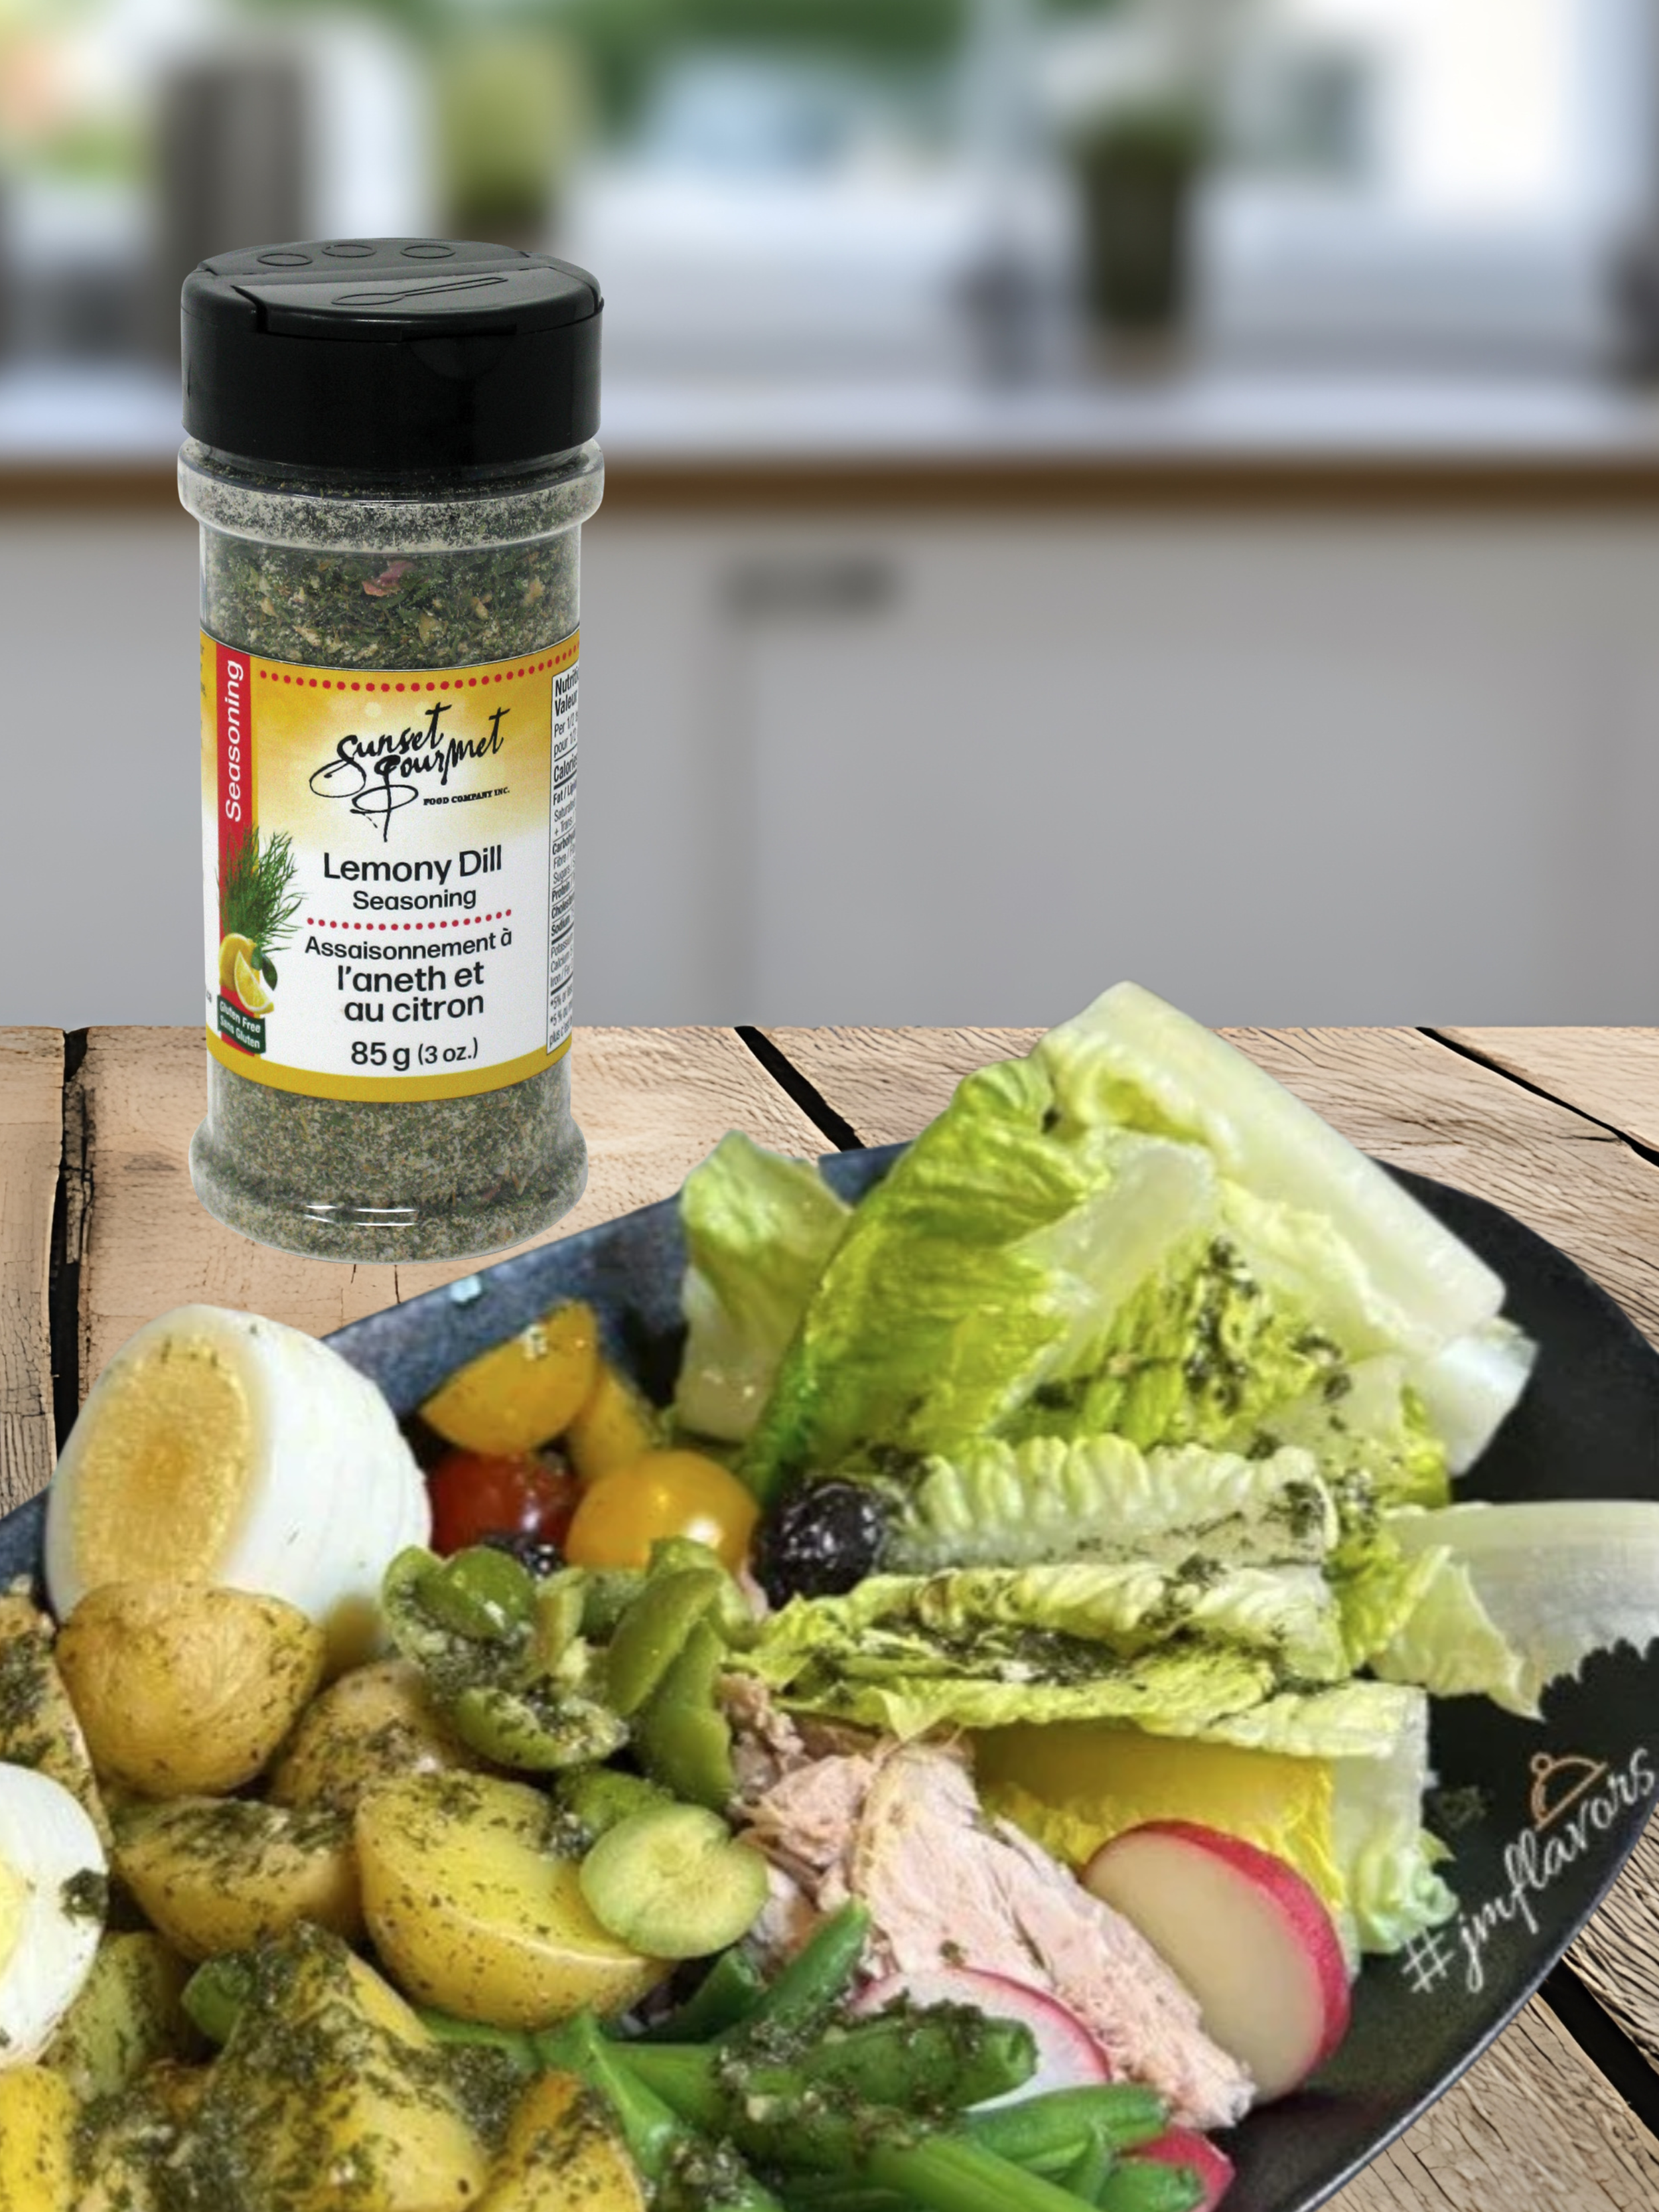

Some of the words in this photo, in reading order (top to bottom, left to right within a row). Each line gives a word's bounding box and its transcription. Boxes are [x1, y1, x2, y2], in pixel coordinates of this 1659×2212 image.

[555, 689, 577, 717] Valeur
[225, 660, 244, 822] Seasoning
[554, 722, 565, 738] Per
[309, 701, 452, 798] Sunset
[554, 737, 568, 759] pour
[451, 790, 492, 803] COMPANY
[494, 786, 510, 798] INC.
[553, 790, 563, 806] Fat
[324, 852, 452, 885] Lemony
[459, 844, 502, 877] Dill
[353, 889, 476, 911] Seasoning
[305, 932, 496, 960] Assaisonnement
[500, 928, 512, 946] à
[338, 965, 447, 992] l'aneth
[454, 962, 484, 988] et
[219, 1000, 240, 1025] Gluten
[242, 1017, 261, 1033] Free
[344, 1001, 384, 1022] au
[392, 995, 484, 1022] citron
[220, 1015, 234, 1035] Sans
[236, 1027, 260, 1049] Gluten
[350, 1041, 387, 1066] 85
[392, 1047, 410, 1071] g
[417, 1043, 437, 1065] (3
[442, 1037, 478, 1063] oz.)
